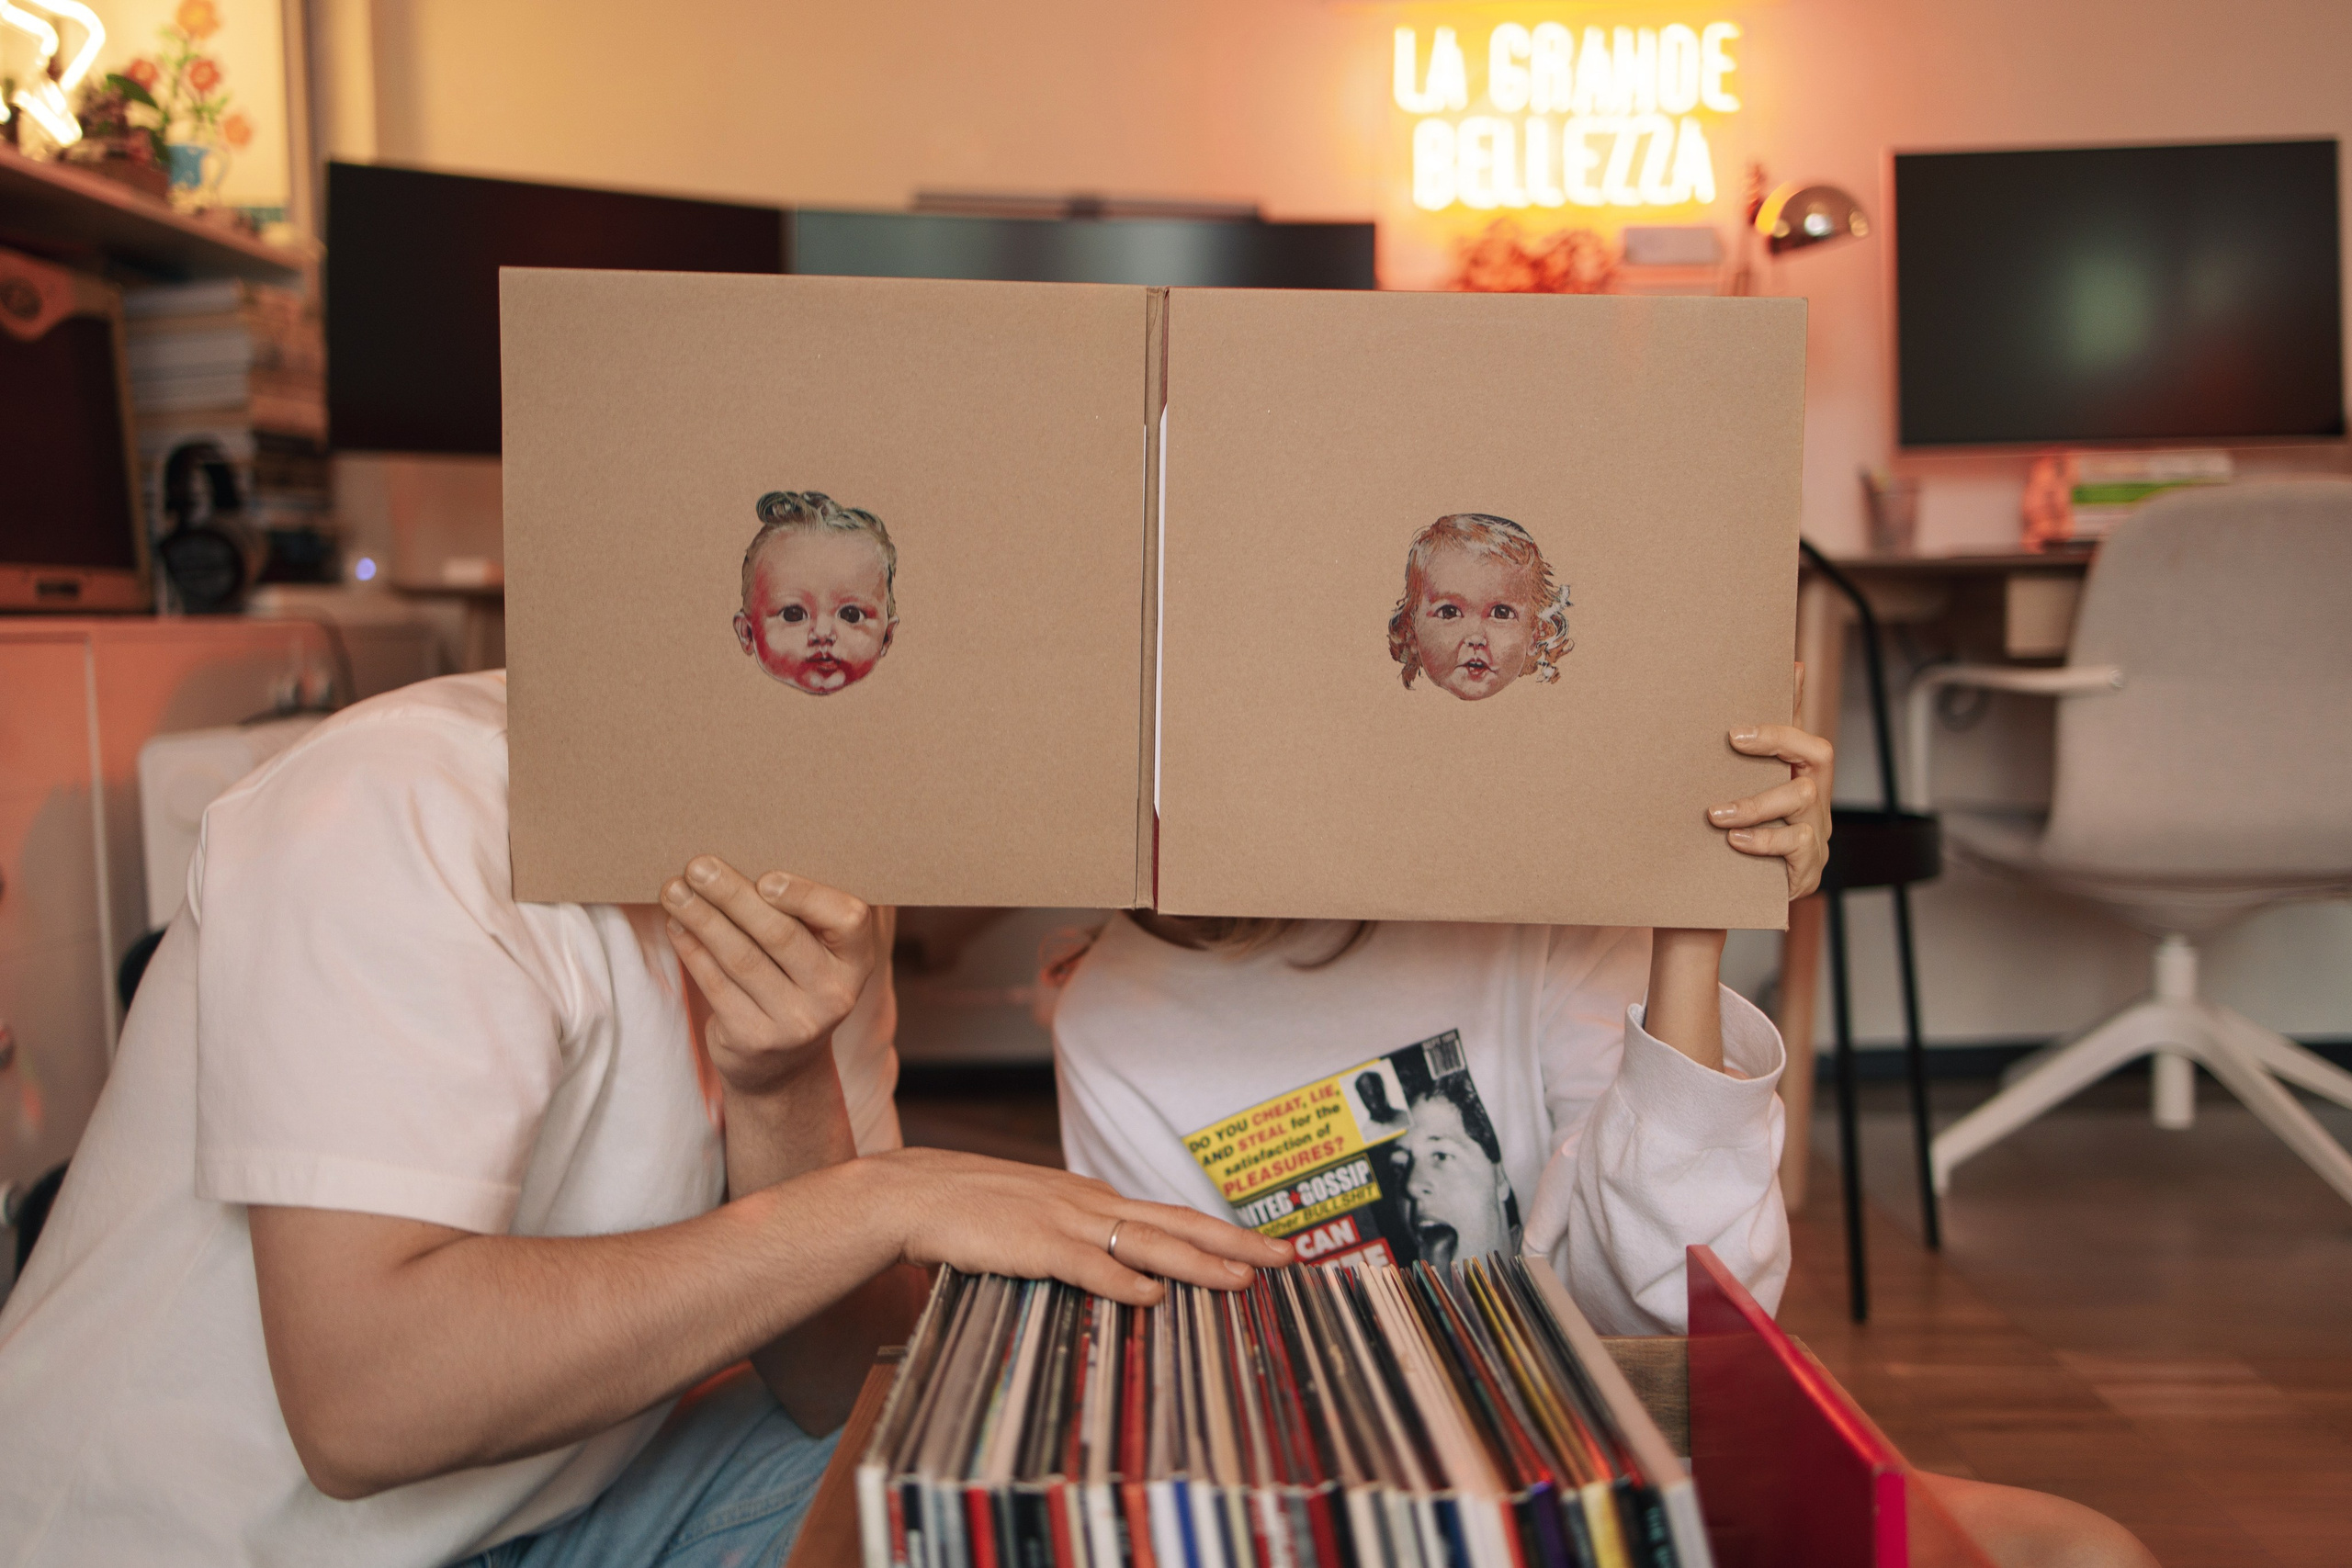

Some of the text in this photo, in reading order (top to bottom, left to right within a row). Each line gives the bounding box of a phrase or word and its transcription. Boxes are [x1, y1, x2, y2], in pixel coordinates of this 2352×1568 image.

[1393, 21, 1742, 115] LA GRANDE
[1413, 113, 1716, 211] BELLEZZA
[1189, 1084, 1340, 1153] DO YOU CHEAT, LIE,
[1202, 1104, 1340, 1167] AND STEAL for the
[1225, 1122, 1330, 1177] satisfaction of
[1223, 1135, 1344, 1198] PLEASURES?
[1296, 1159, 1371, 1206] GOSSIP
[1295, 1219, 1357, 1258] CAN
